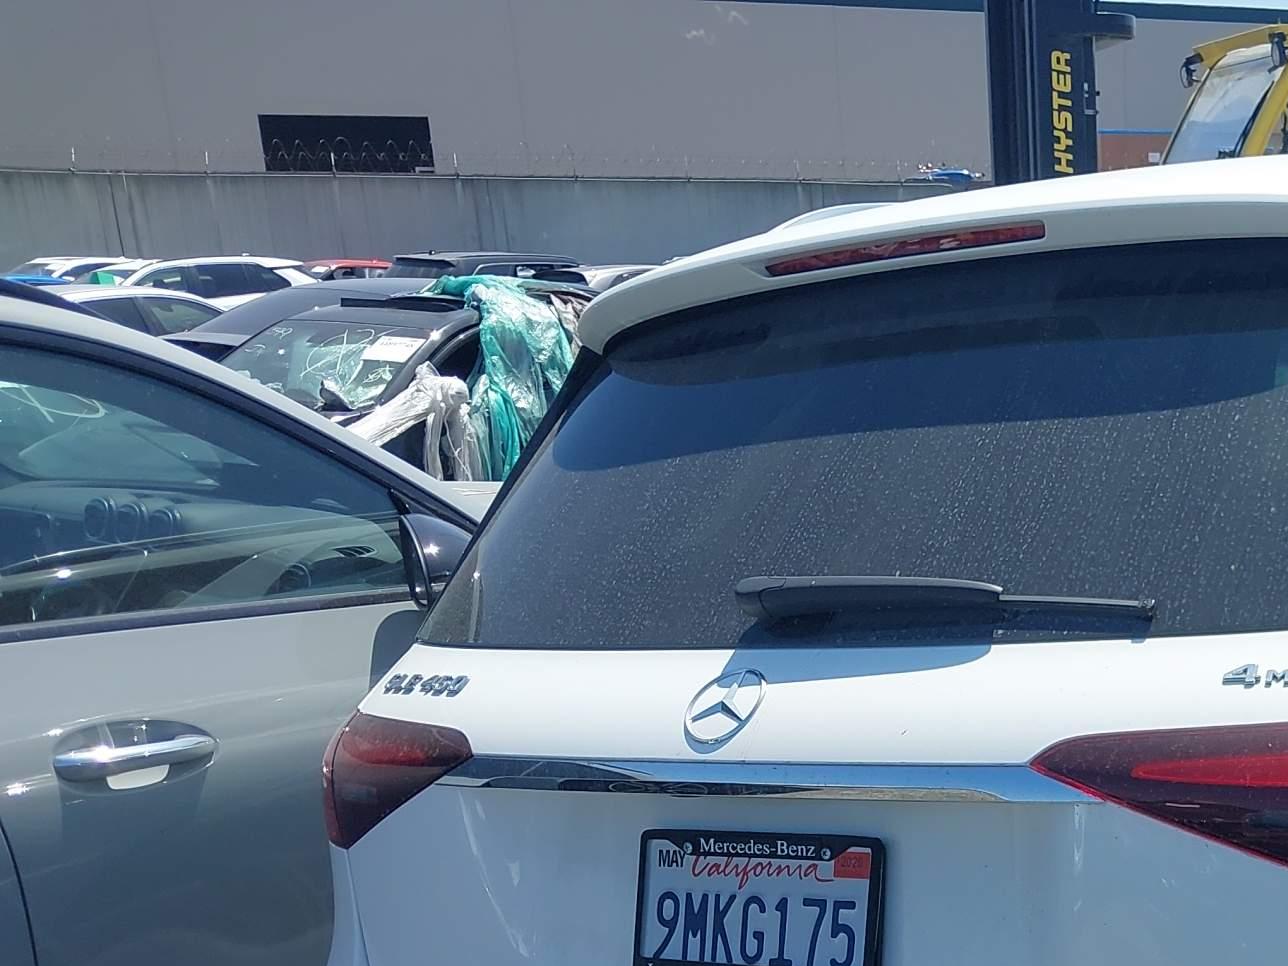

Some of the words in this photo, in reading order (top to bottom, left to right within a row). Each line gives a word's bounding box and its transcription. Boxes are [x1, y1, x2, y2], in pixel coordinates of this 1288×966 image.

[1051, 50, 1074, 174] HYSTER
[658, 848, 686, 868] MAY
[699, 838, 816, 858] Mercedes-Benz
[691, 855, 834, 890] California
